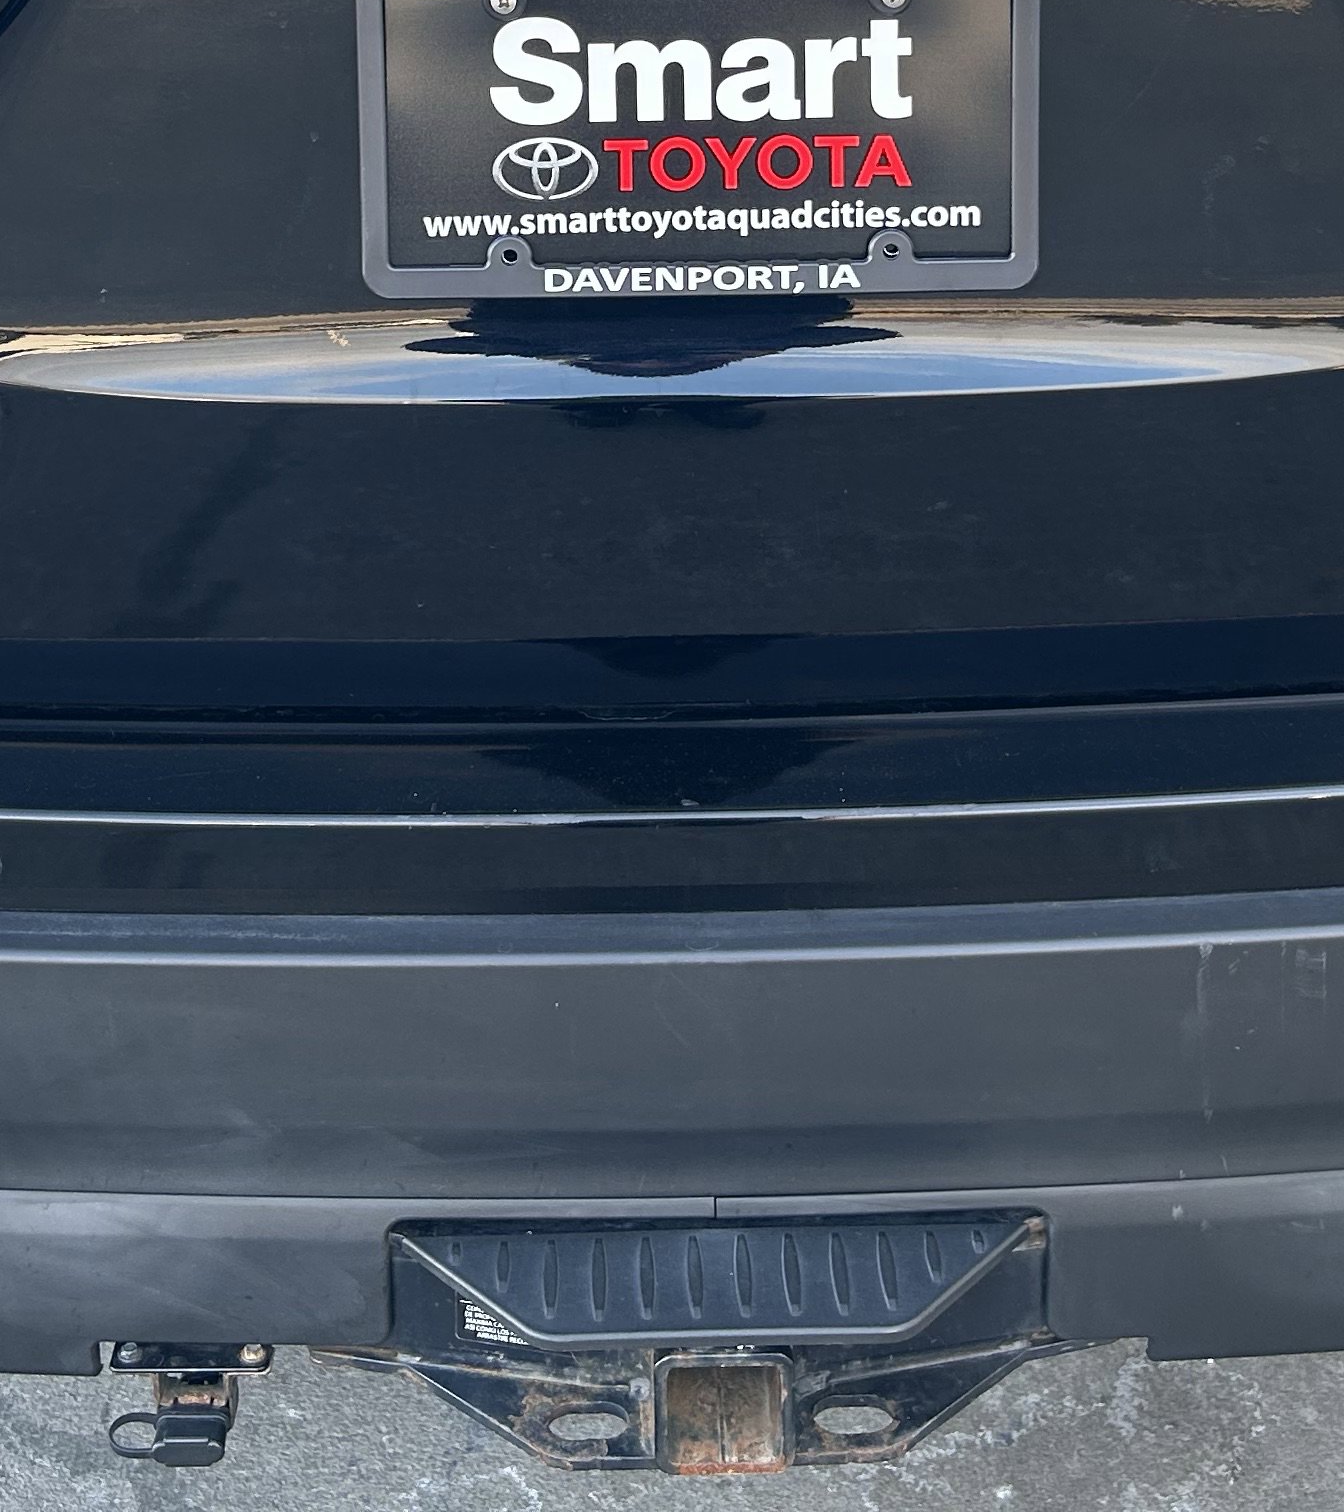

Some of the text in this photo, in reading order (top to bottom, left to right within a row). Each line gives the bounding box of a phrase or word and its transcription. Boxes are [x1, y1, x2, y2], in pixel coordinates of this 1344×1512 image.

[489, 16, 913, 126] Smart
[602, 134, 913, 192] TOYOTA
[423, 200, 981, 239] www.smarttoyotaquadcities.com
[543, 263, 862, 295] DAVENPORT, IA
